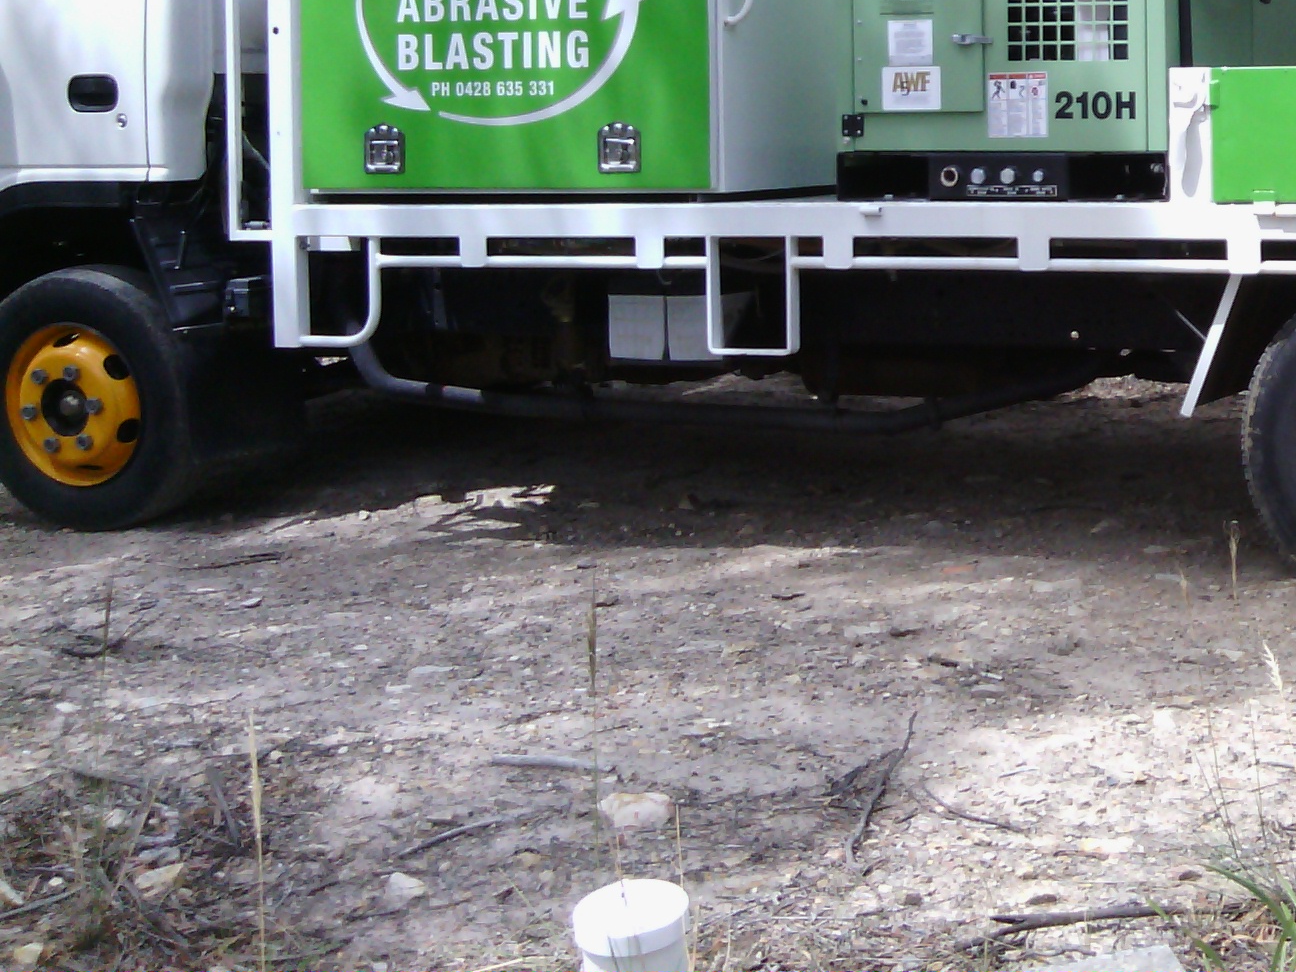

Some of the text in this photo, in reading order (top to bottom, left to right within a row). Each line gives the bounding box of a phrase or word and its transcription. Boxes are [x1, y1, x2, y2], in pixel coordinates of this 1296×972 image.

[397, 30, 589, 71] BLASTING
[431, 80, 554, 97] PH 0428 635 331
[1055, 91, 1136, 120] 210H
